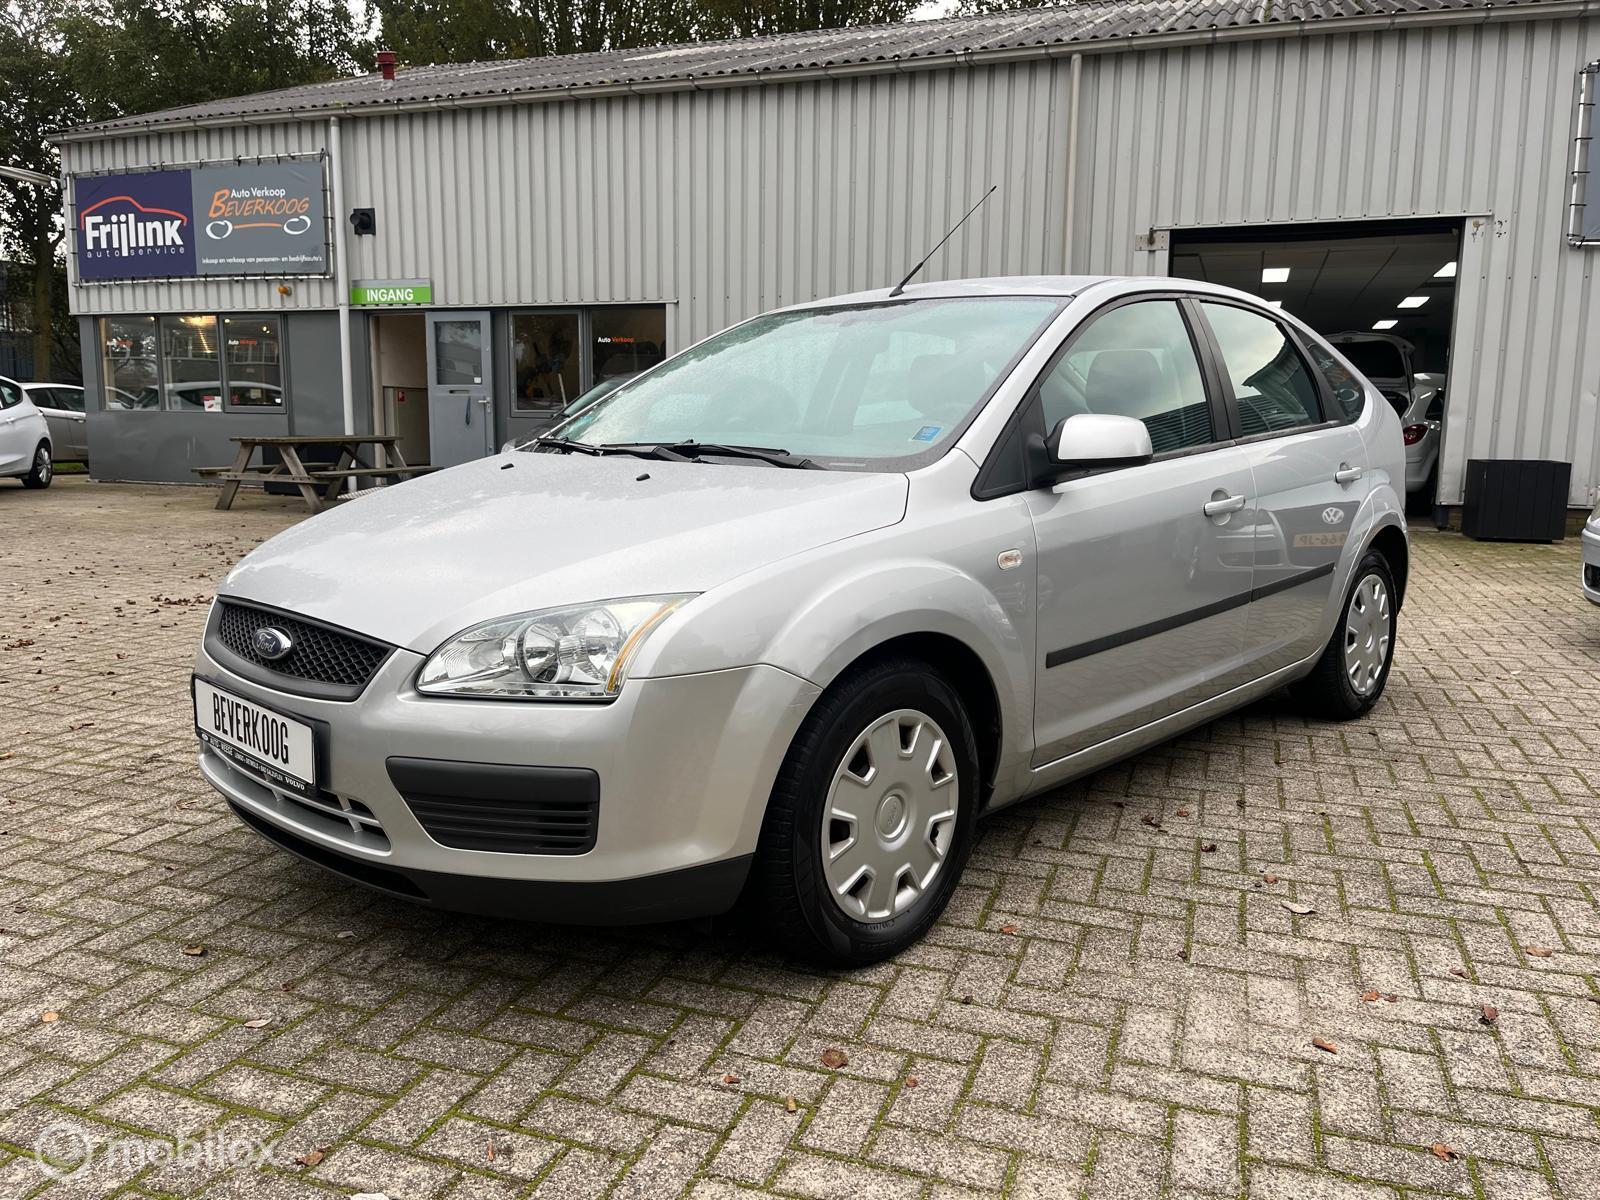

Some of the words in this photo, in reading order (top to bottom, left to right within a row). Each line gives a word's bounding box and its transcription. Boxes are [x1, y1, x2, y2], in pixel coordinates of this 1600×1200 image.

[230, 188, 250, 198] Auto
[250, 186, 286, 199] Verkoop
[208, 188, 310, 218] BEVERKOOG
[87, 249, 120, 259] auto
[130, 246, 185, 256] service
[366, 288, 414, 302] INGANG
[597, 336, 611, 344] Auto
[212, 692, 290, 764] BEVERKOOG
[284, 777, 305, 791] VOLVO
